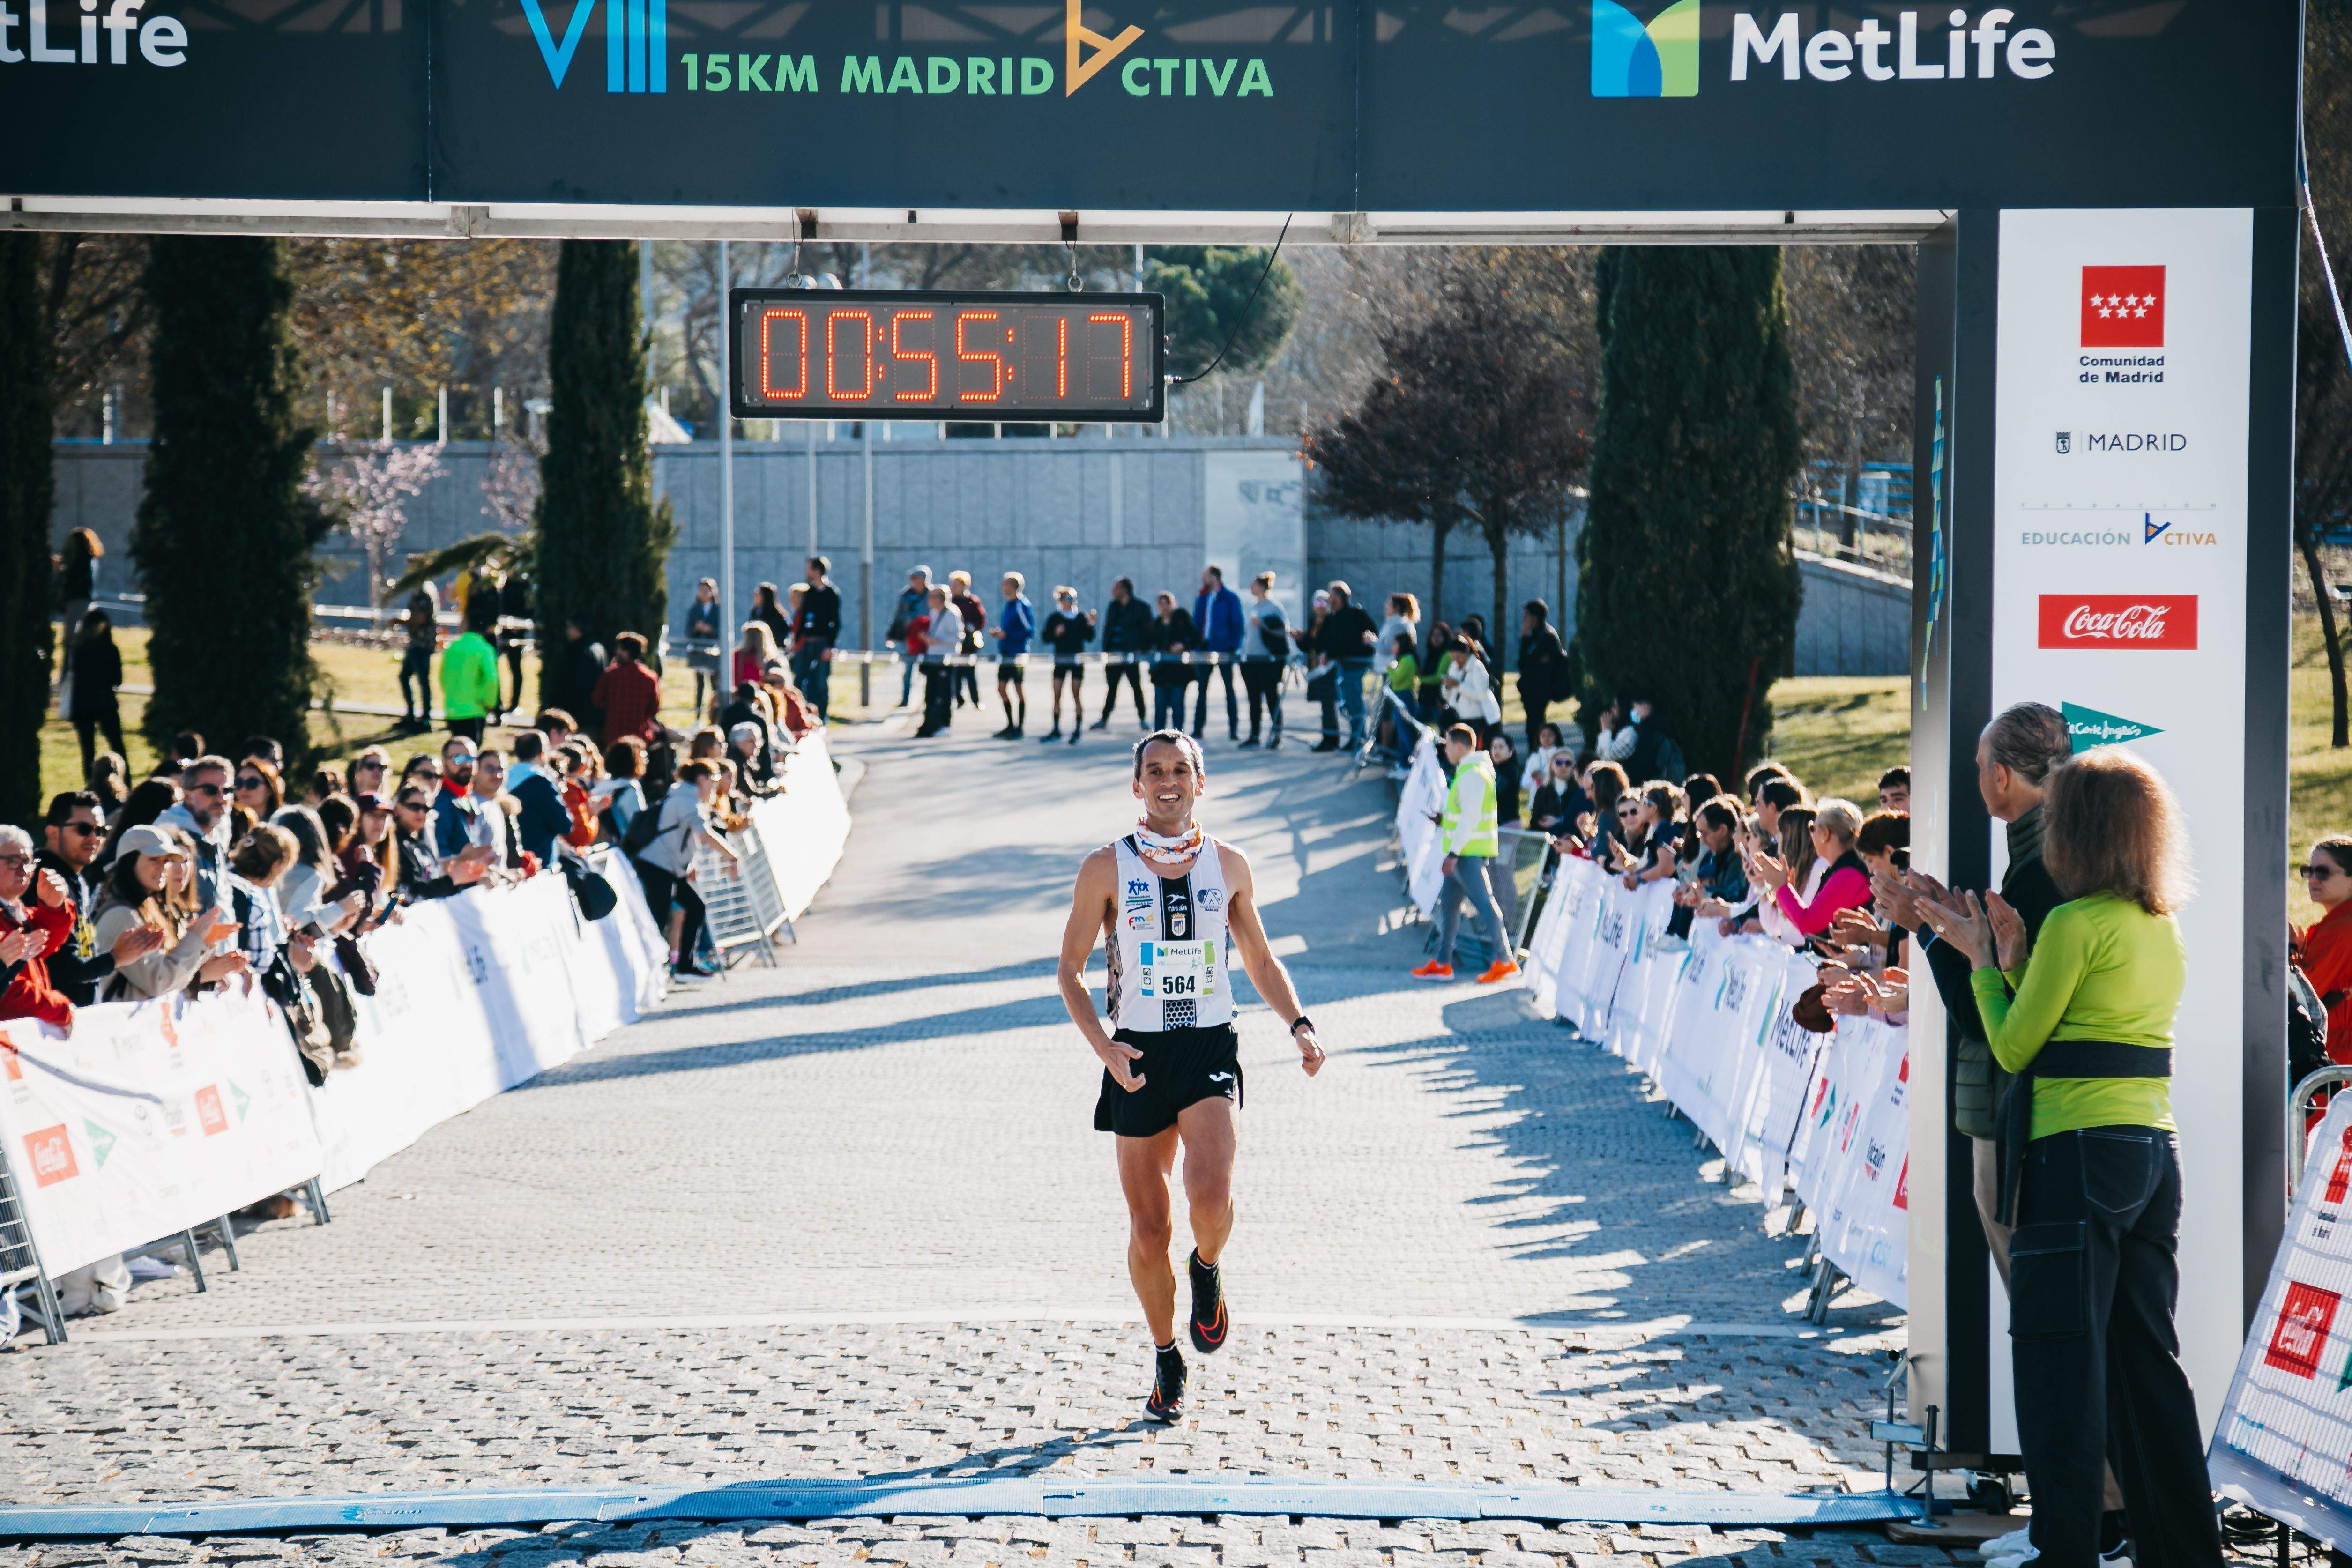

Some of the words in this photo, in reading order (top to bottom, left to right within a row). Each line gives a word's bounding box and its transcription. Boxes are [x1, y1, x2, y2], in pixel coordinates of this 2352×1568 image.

[1731, 8, 2056, 82] MetLife
[681, 53, 819, 92] 15KM
[840, 55, 1054, 95] MADRID
[762, 309, 1130, 401] 00:55:17
[2079, 356, 2165, 366] Comunidad
[2079, 371, 2099, 383] de
[2106, 371, 2164, 383] Madrid
[2089, 434, 2187, 451] MADRID
[2021, 528, 2131, 545] EDUCACIÓN
[2063, 605, 2172, 639] Coca-Cola
[1168, 903, 1188, 912] rasán
[1163, 975, 1196, 994] 564
